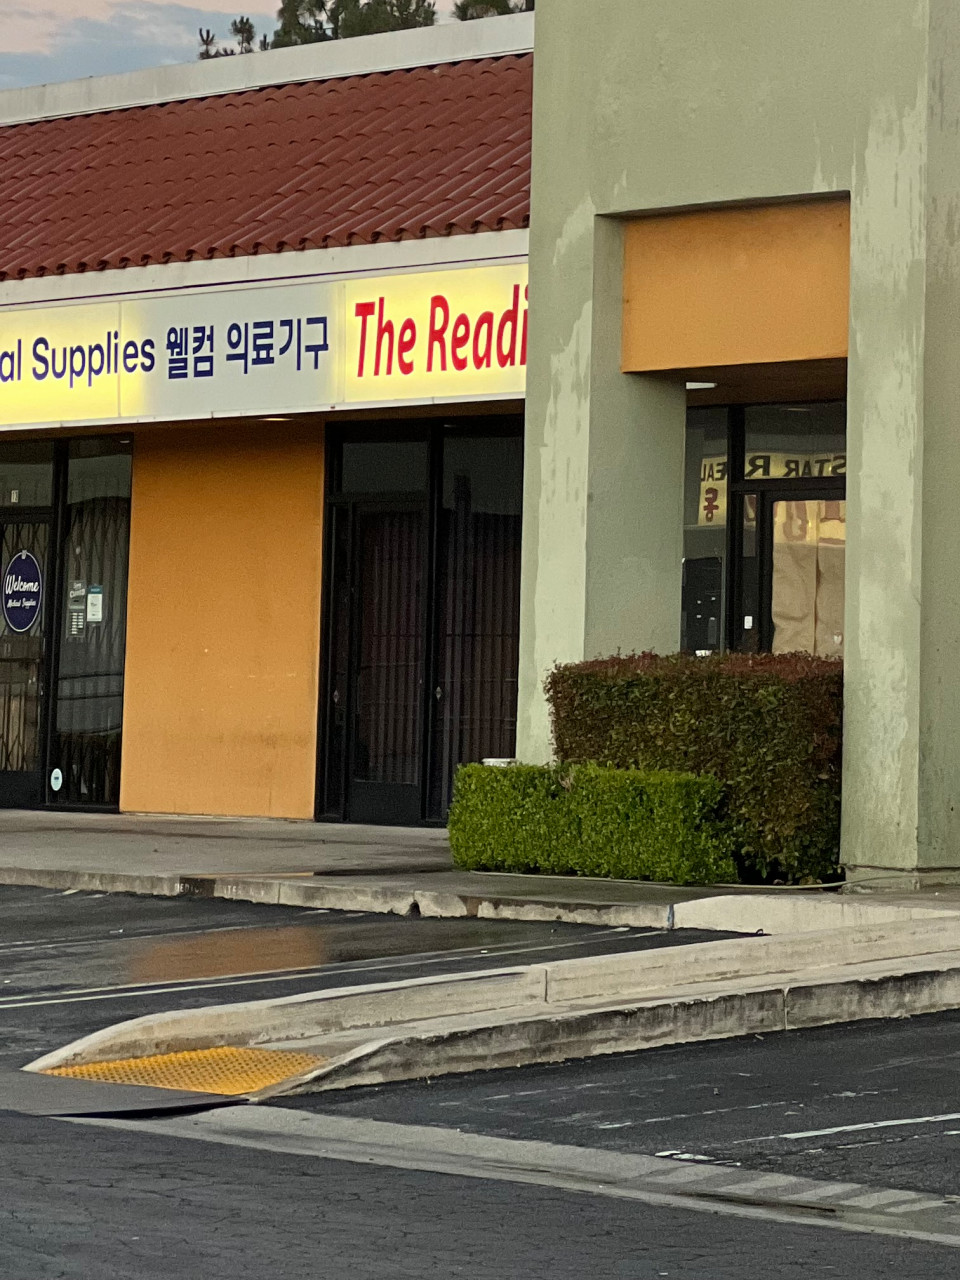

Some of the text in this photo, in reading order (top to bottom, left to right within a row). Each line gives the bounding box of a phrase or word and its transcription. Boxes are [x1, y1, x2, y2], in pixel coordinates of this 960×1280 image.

[0, 330, 155, 388] al Supplies
[166, 316, 329, 379] 웰컴 의료기구
[355, 297, 416, 377] The
[5, 575, 40, 594] Welcome
